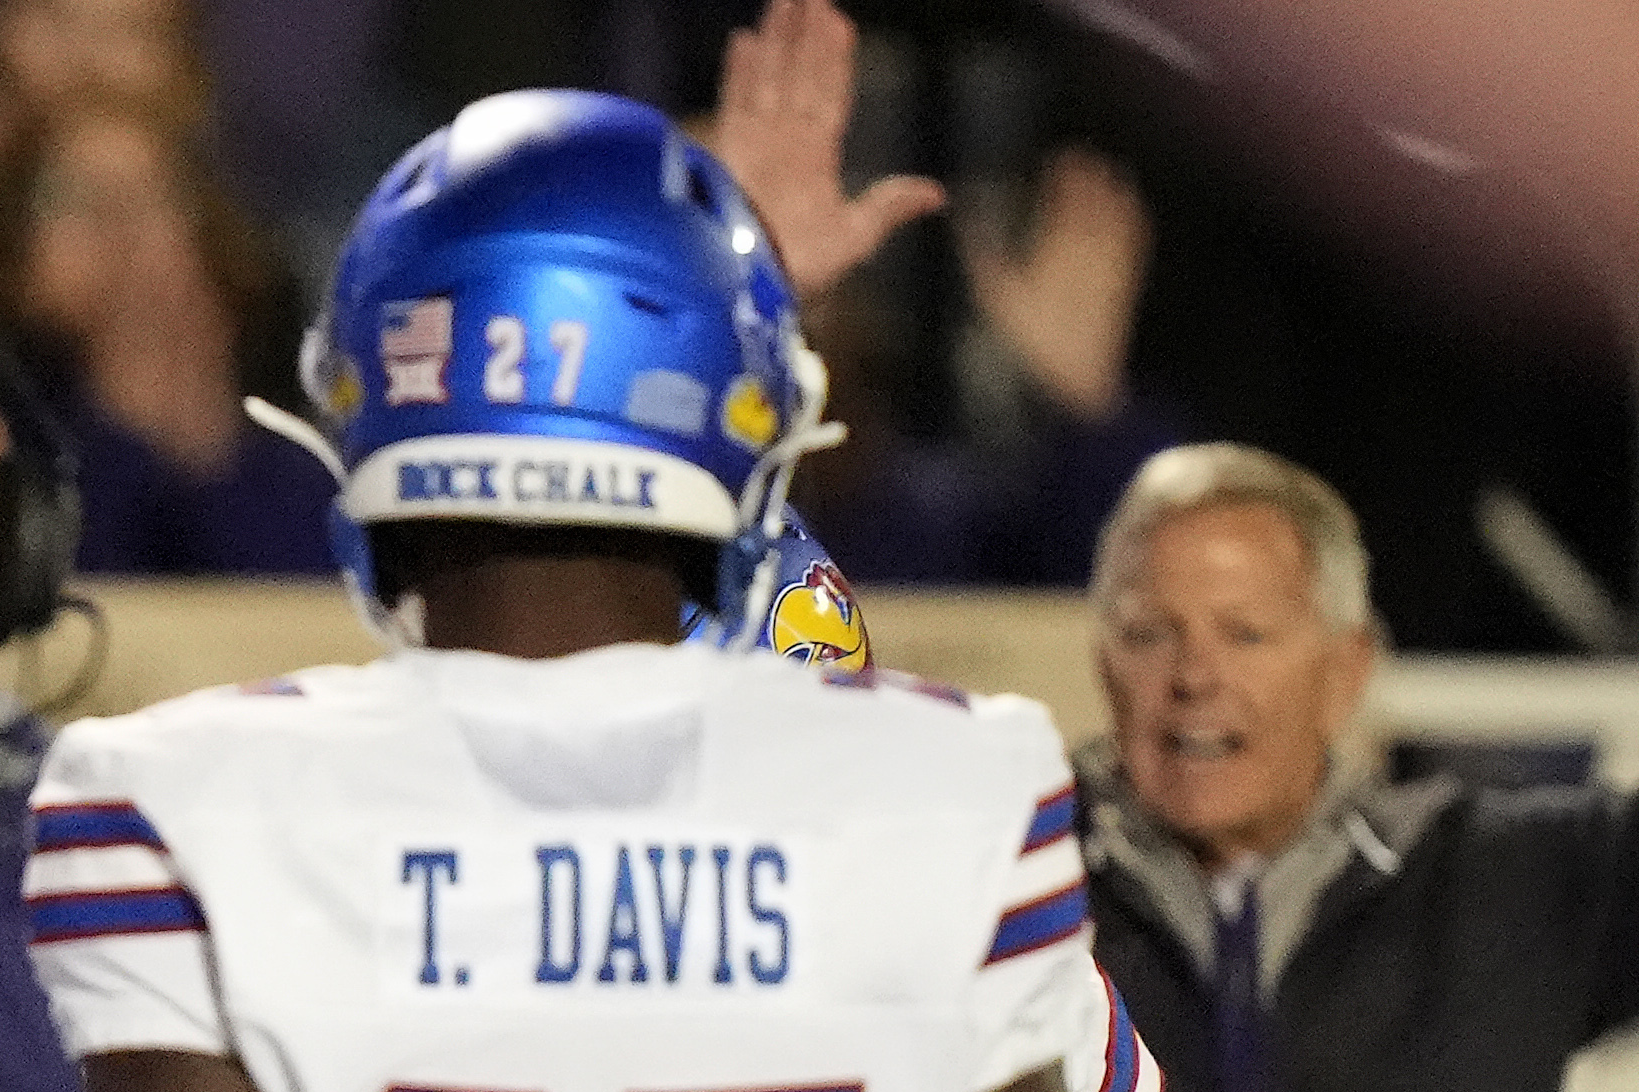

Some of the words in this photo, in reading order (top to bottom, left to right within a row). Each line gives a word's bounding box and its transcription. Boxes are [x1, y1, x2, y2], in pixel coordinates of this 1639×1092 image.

[483, 314, 588, 404] 27
[397, 460, 498, 502] ROCK
[513, 459, 655, 508] CHALK
[400, 849, 469, 986] T.
[534, 845, 789, 985] DAVIS
